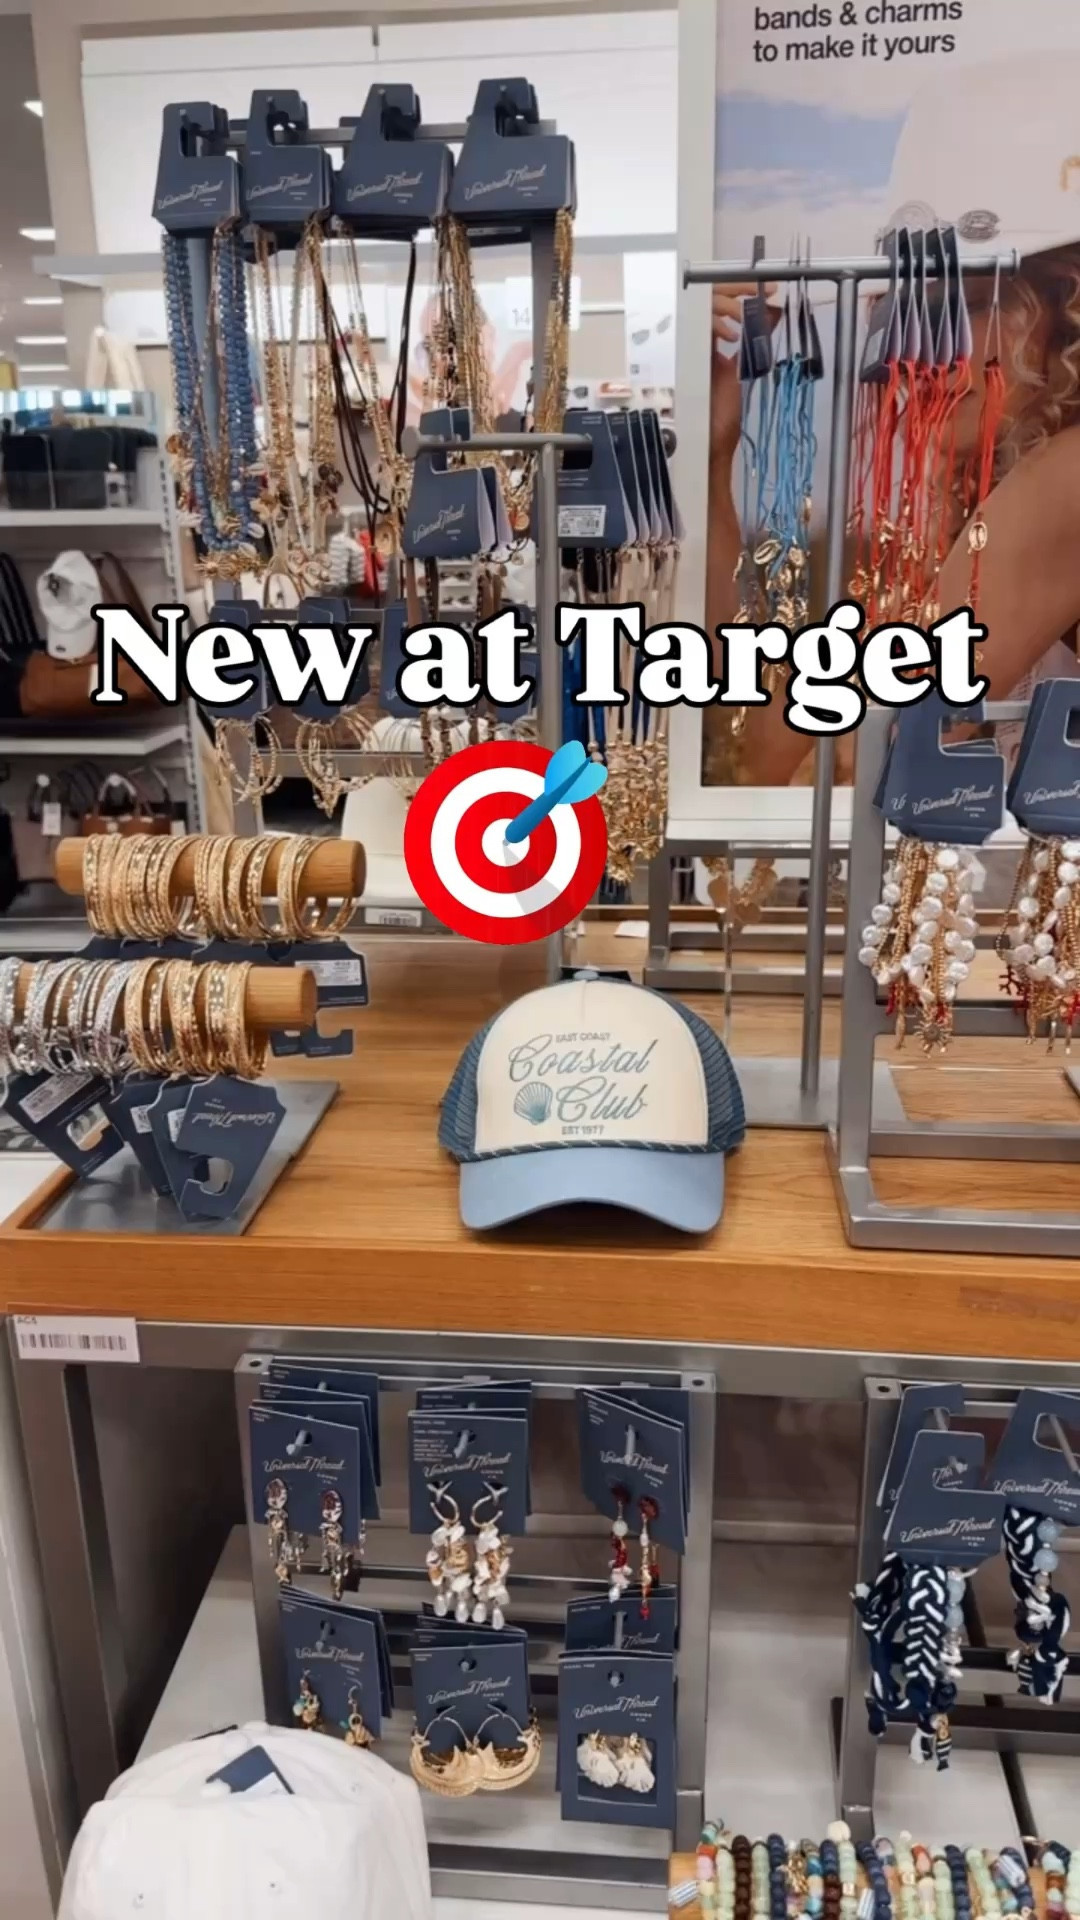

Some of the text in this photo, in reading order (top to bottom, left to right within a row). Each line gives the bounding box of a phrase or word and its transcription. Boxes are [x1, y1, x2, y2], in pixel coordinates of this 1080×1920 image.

[754, 0, 963, 31] bands & charms
[753, 33, 956, 62] to make it yours
[508, 1033, 659, 1082] Coastal
[555, 1075, 649, 1123] Club
[561, 1126, 580, 1135] EST
